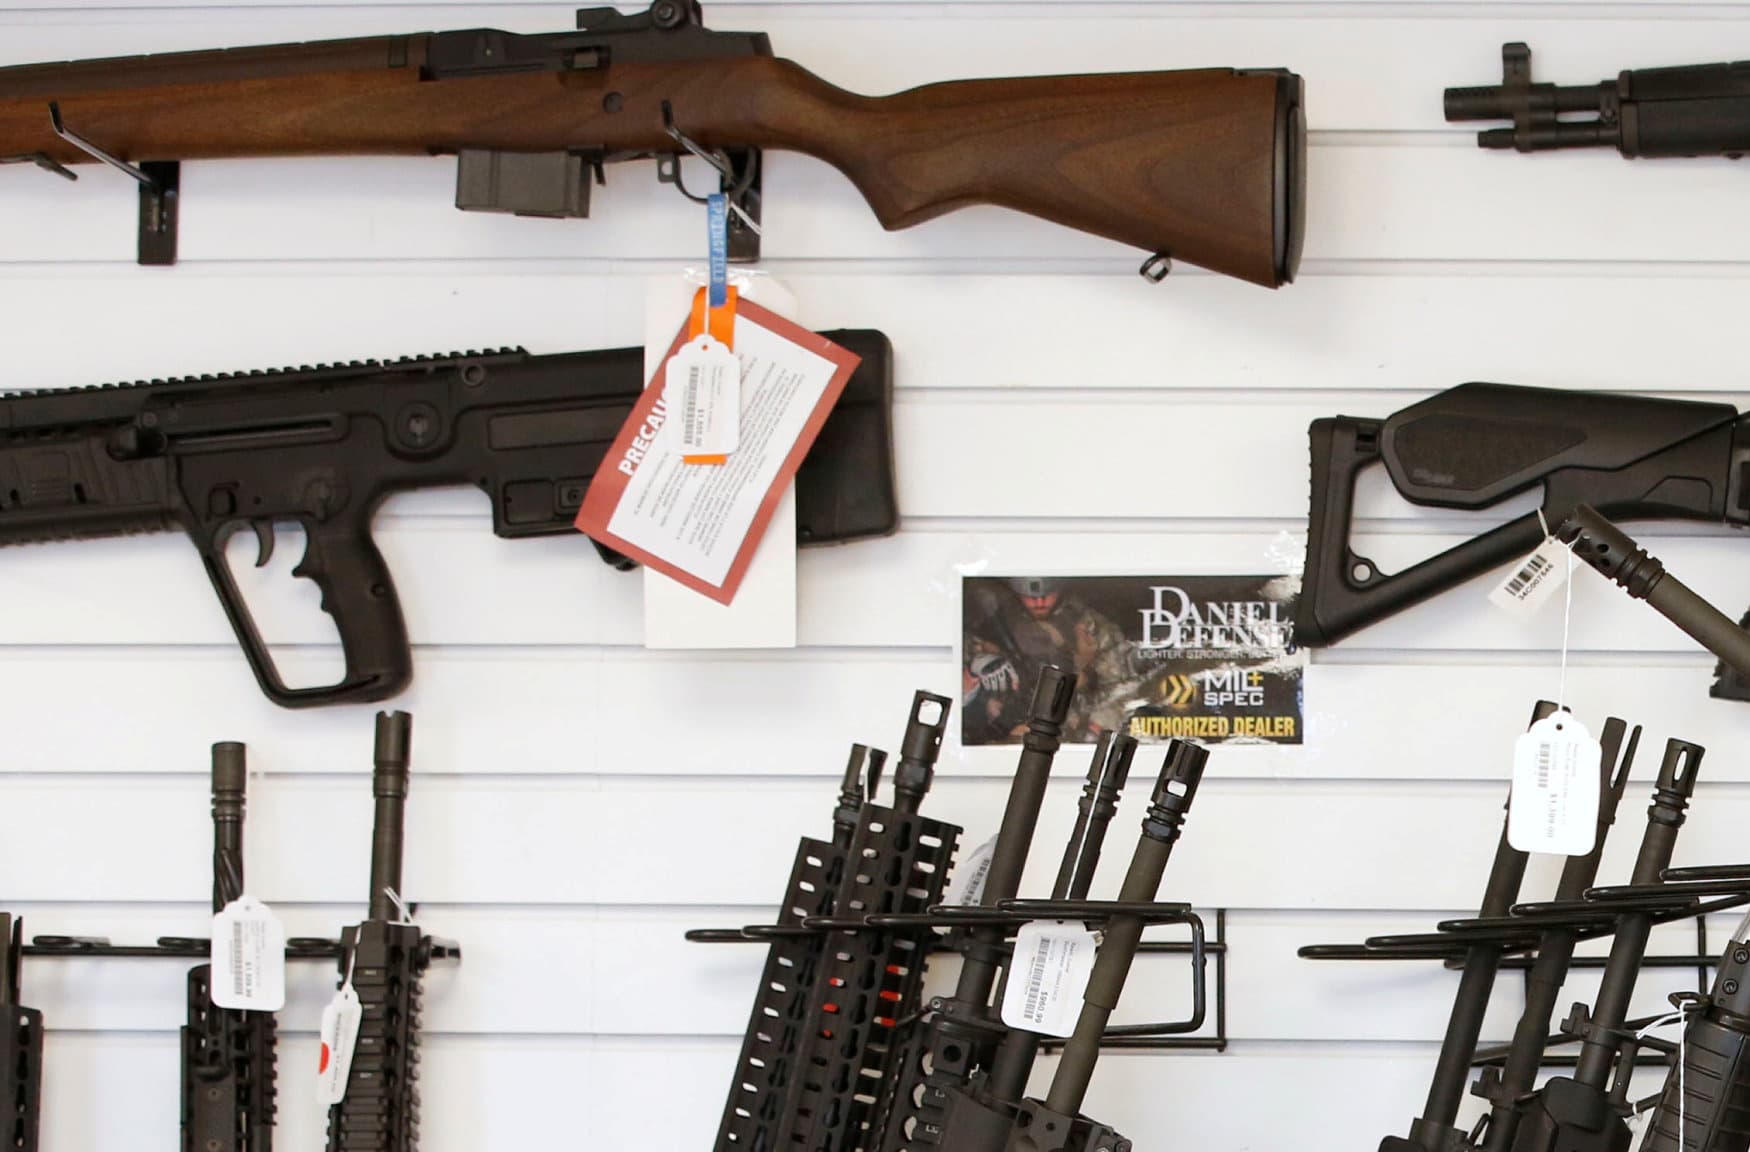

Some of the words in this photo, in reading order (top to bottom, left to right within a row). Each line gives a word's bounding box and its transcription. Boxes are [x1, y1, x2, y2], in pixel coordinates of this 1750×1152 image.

[1149, 585, 1290, 627] DANIEL
[1138, 608, 1294, 650] DEFENSE
[1203, 692, 1264, 707] SPEC
[1130, 716, 1229, 737] AUTHORIZED
[1234, 716, 1295, 737] DEALER
